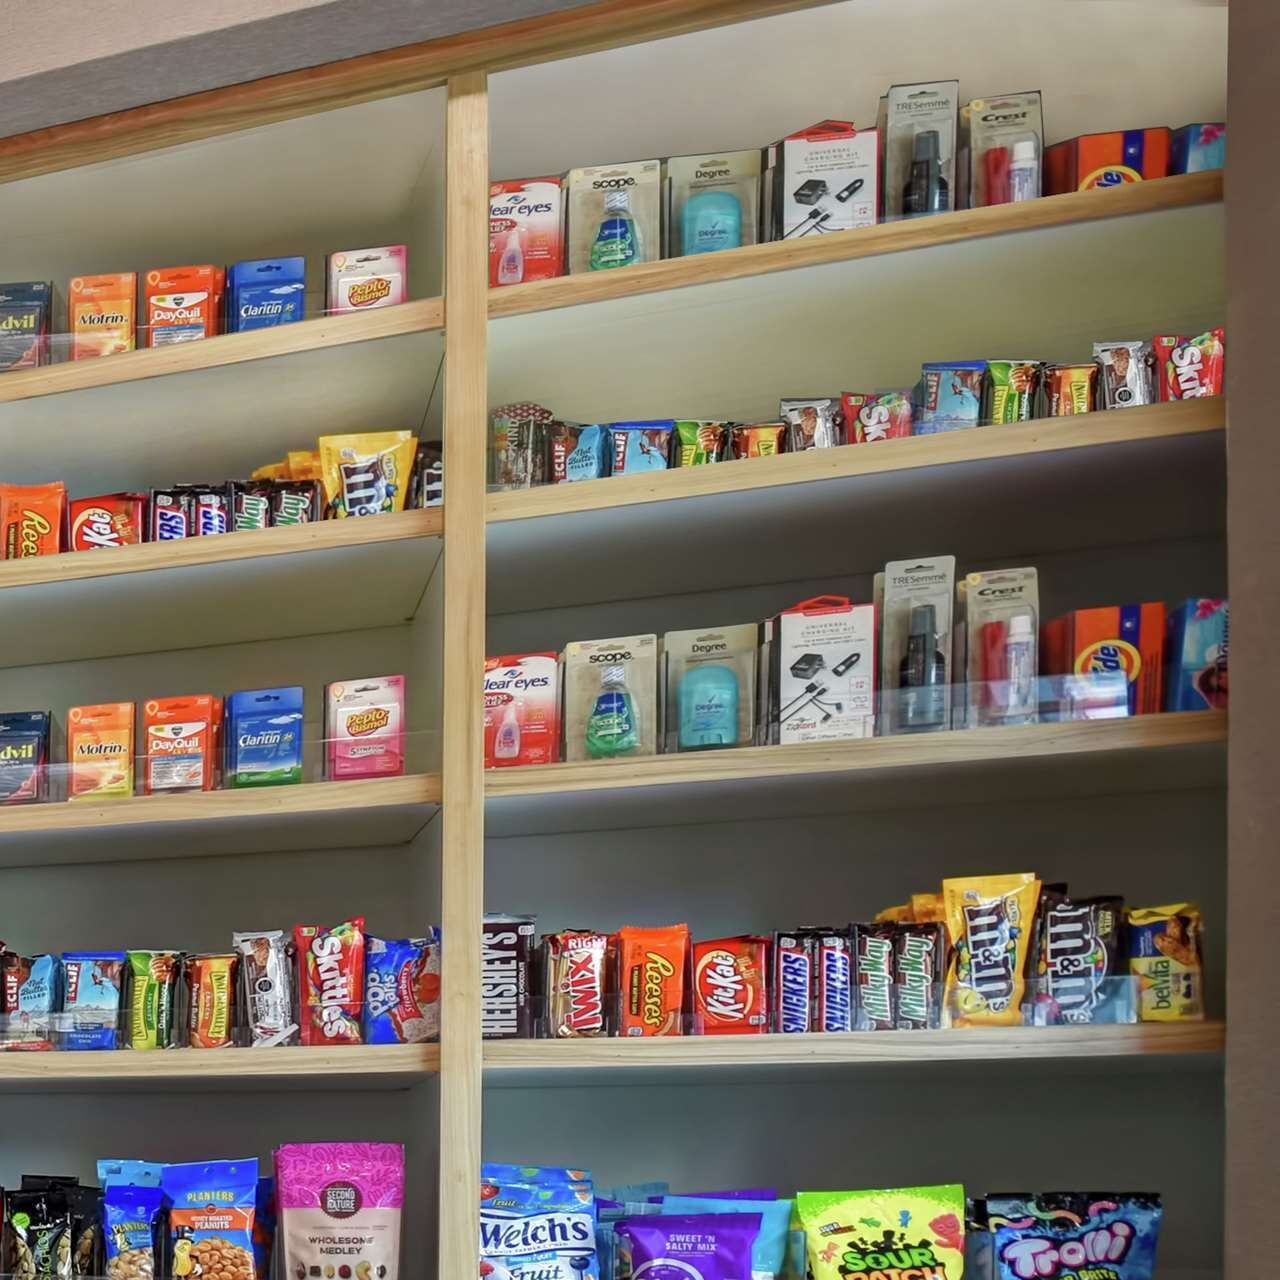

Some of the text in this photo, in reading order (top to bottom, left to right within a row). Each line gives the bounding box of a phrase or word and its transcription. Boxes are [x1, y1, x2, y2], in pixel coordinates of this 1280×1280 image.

[981, 110, 1028, 123] Crest
[695, 167, 731, 180] Degree
[591, 175, 635, 191] scope
[517, 200, 553, 217] eyes
[153, 308, 201, 325] DayQuil
[240, 301, 282, 318] Claritin
[78, 312, 124, 324] Motrin
[978, 584, 1025, 598] Crest
[691, 641, 727, 653] Degree
[589, 650, 633, 665] scope
[514, 675, 549, 691] eyes
[350, 717, 389, 735] Bismol
[152, 737, 200, 754] DayQuil
[239, 734, 281, 748] Claritin
[77, 743, 123, 756] Motrin
[311, 935, 351, 1038] Skittles
[482, 929, 518, 1035] HERSHEY'S
[641, 950, 676, 1028] Reese's
[1151, 959, 1171, 1010] belVita
[782, 953, 809, 1034] SNICKERS
[824, 953, 849, 1034] SNICKERS
[187, 1191, 234, 1203] PLANTERS
[327, 1187, 355, 1201] SECOND
[194, 1220, 230, 1230] PEANUTS
[308, 1235, 375, 1246] WHOLESOME
[481, 1218, 590, 1250] Welch's
[668, 1234, 703, 1243] SWEET
[319, 1246, 362, 1255] MEDLEY
[665, 1241, 718, 1252] SALTY MIX
[1003, 1222, 1137, 1280] Trolli
[842, 1246, 937, 1271] SOUR
